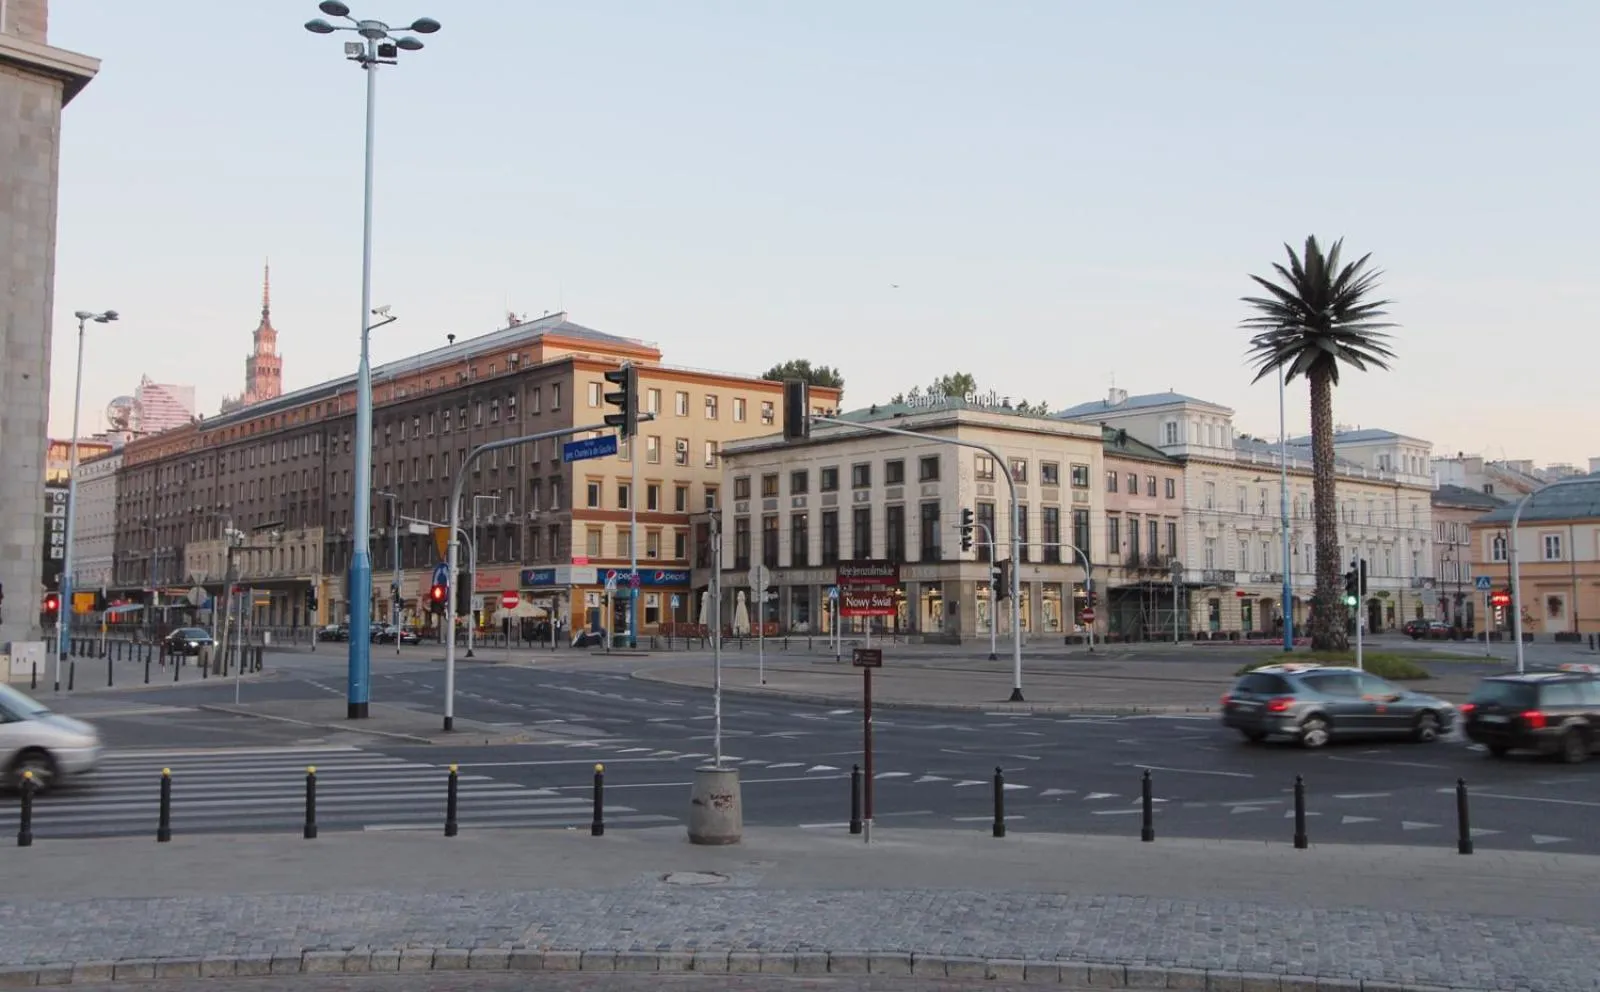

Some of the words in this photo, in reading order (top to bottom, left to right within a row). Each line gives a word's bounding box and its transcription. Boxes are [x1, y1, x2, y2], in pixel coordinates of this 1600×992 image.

[907, 391, 947, 408] empik
[964, 389, 1003, 408] empik
[846, 597, 870, 609] Nowy
[872, 594, 892, 607] Świat
